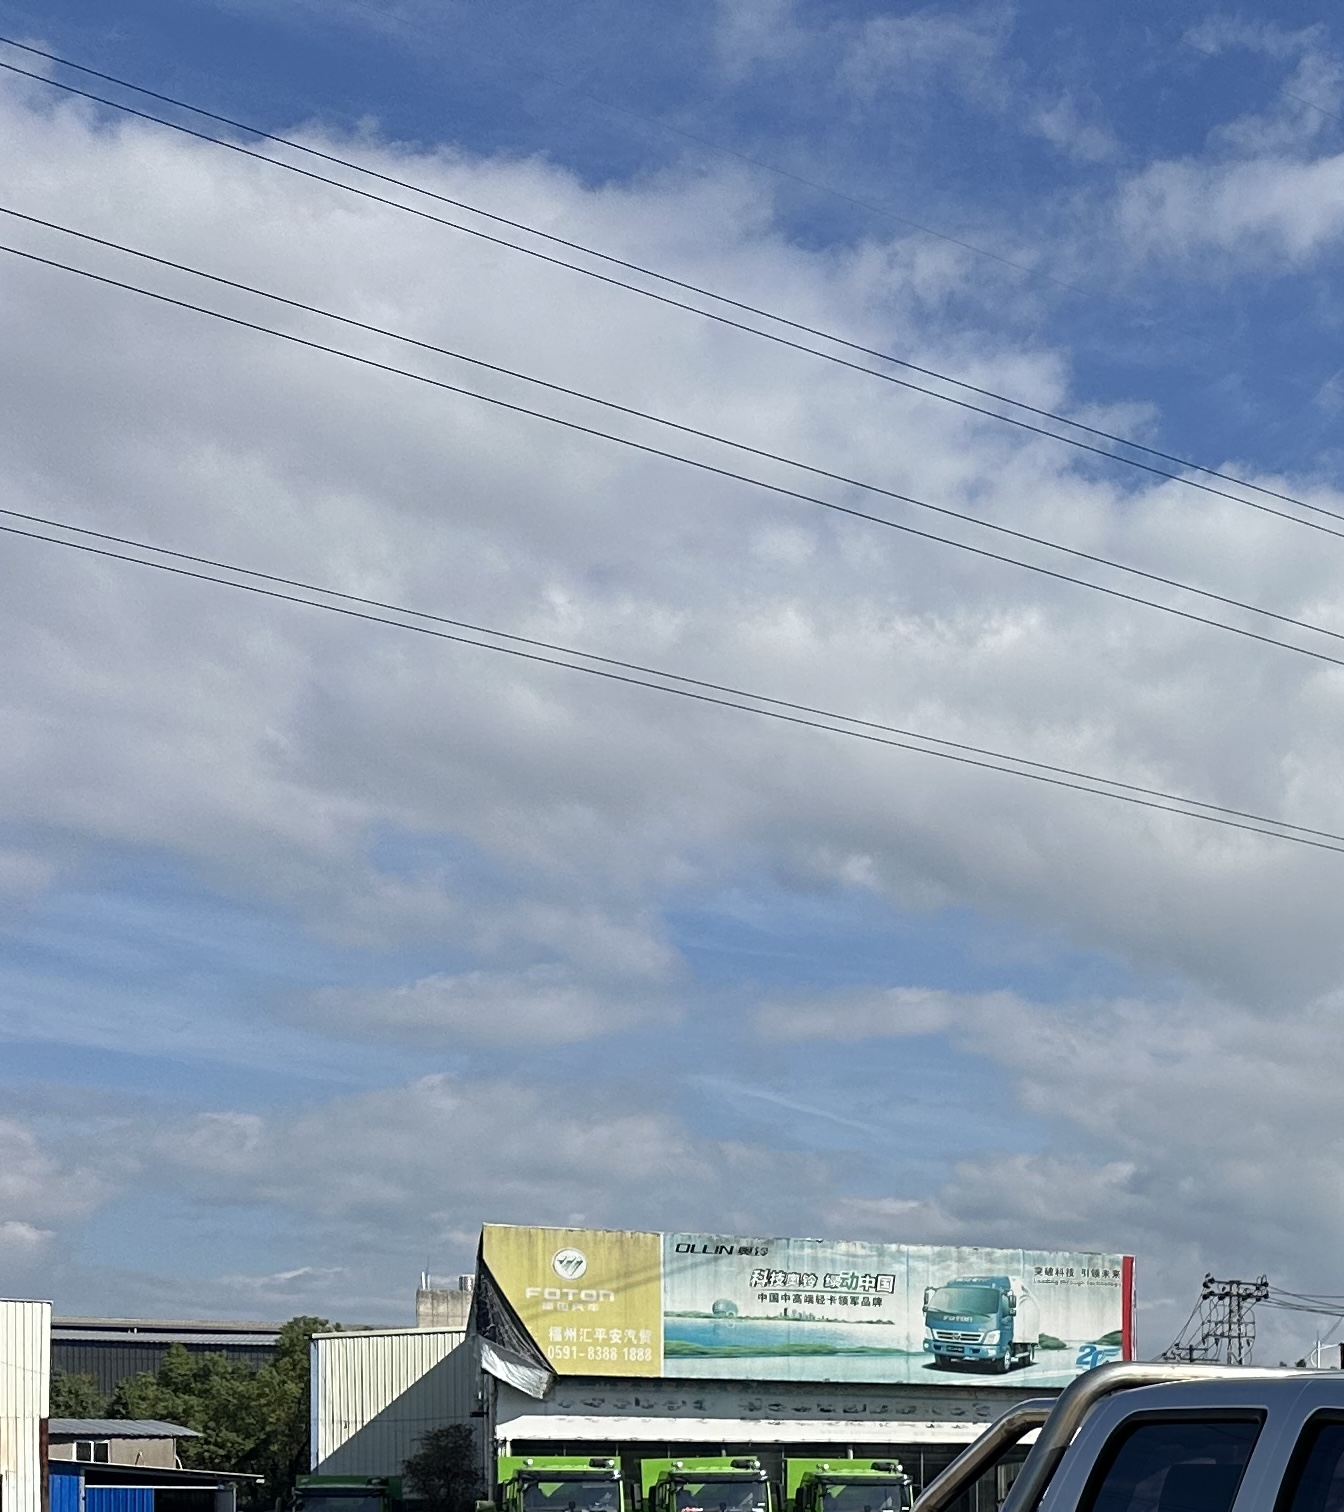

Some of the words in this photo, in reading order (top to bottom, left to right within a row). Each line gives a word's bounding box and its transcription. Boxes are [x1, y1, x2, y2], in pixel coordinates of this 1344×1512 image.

[676, 1243, 733, 1255] OLLIN
[750, 1269, 818, 1288] 科技奥铃
[823, 1271, 895, 1294] 绿动中国
[757, 1292, 883, 1307] 中国中高端轻卡领军品牌
[623, 1347, 652, 1362] 1888
